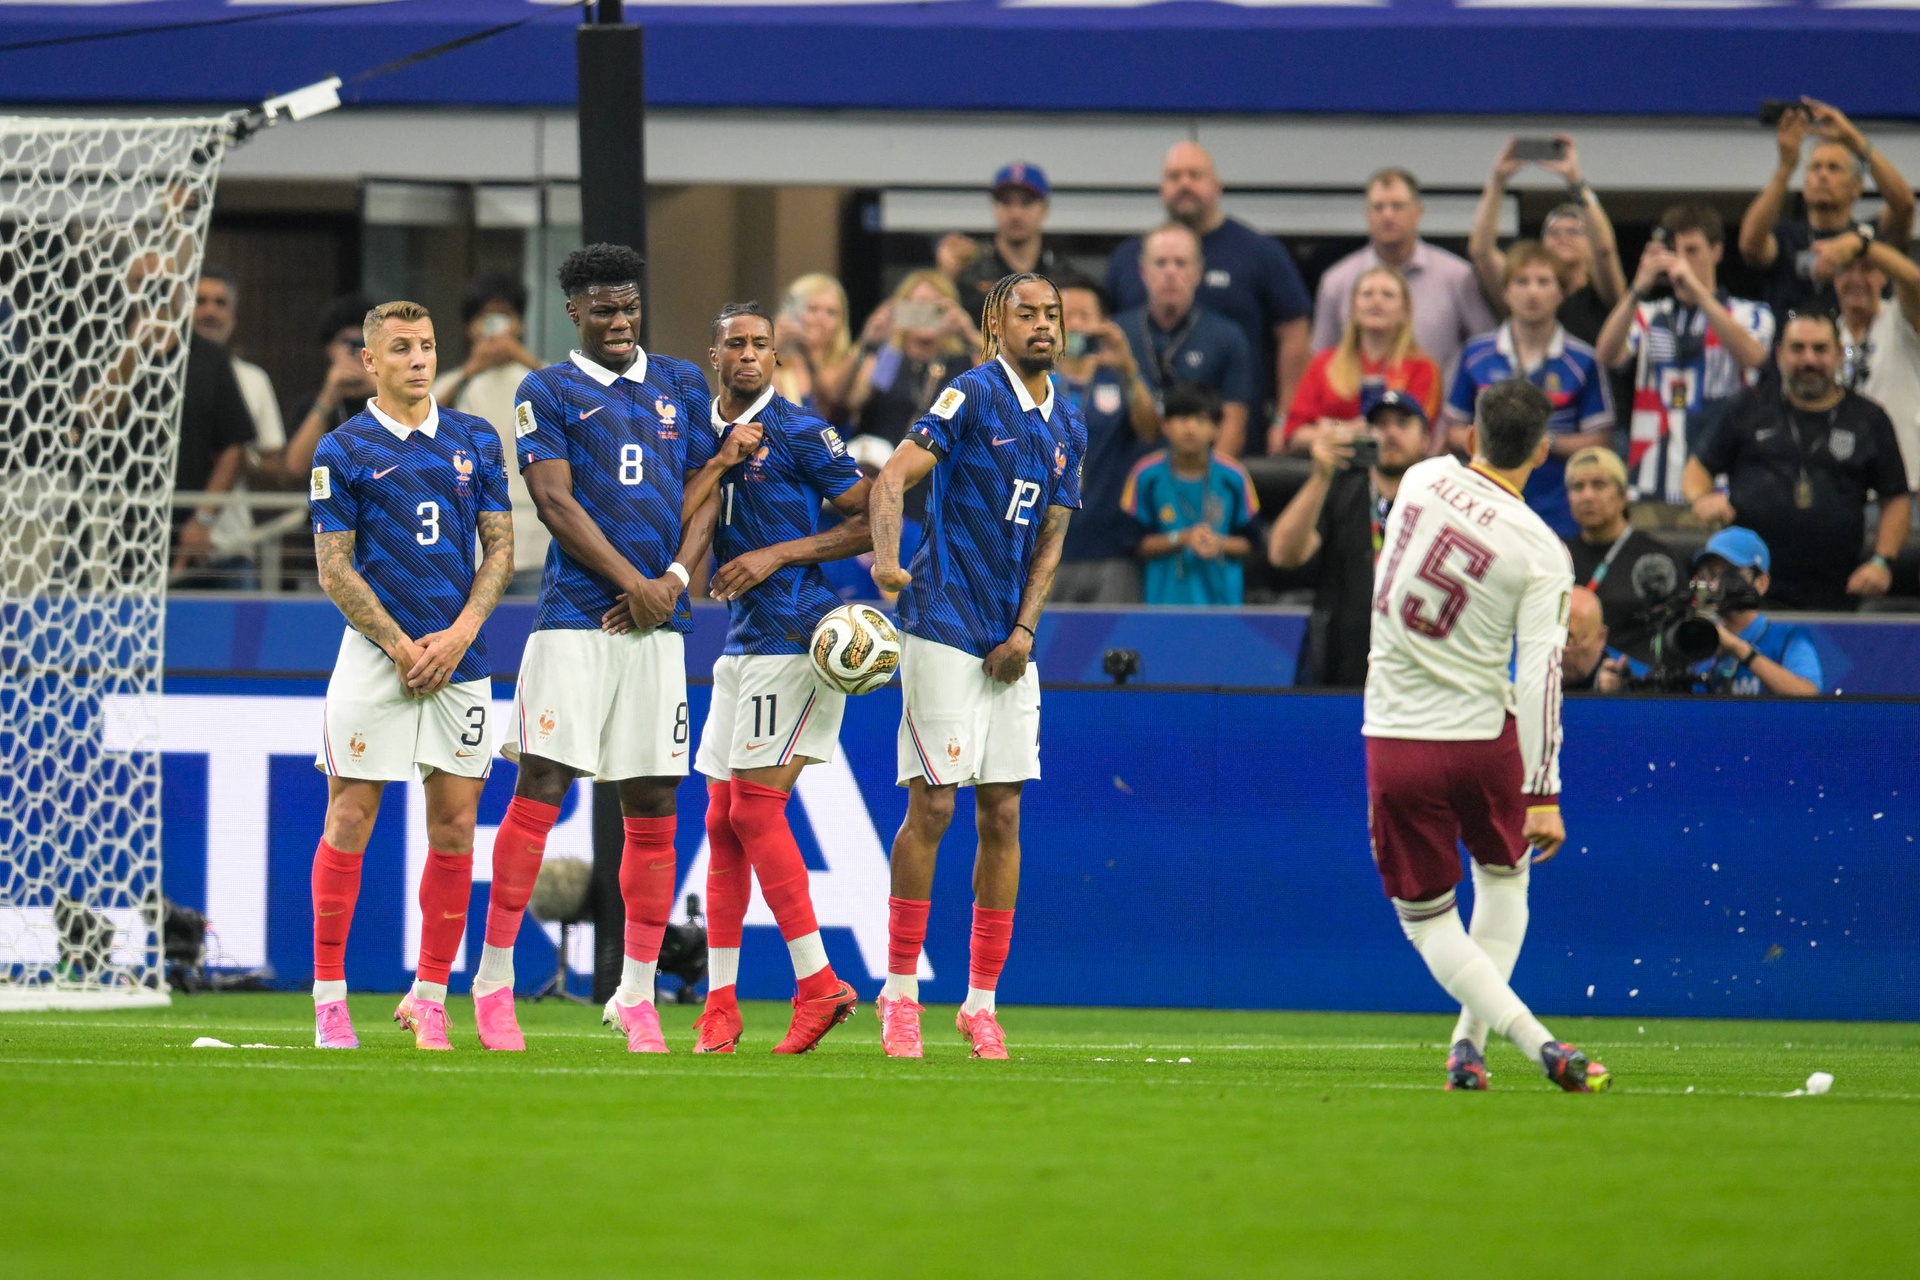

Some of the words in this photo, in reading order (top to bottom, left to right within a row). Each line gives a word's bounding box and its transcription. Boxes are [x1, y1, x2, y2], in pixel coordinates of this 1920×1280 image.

[619, 443, 643, 485] 8
[416, 501, 440, 546] 3
[719, 483, 735, 526] 1
[1005, 478, 1042, 526] 12
[1429, 478, 1477, 518] ALEX
[1477, 508, 1498, 532] B.
[1376, 503, 1498, 640] 15
[461, 706, 486, 747] 3
[672, 702, 688, 744] 8
[752, 693, 777, 738] 11
